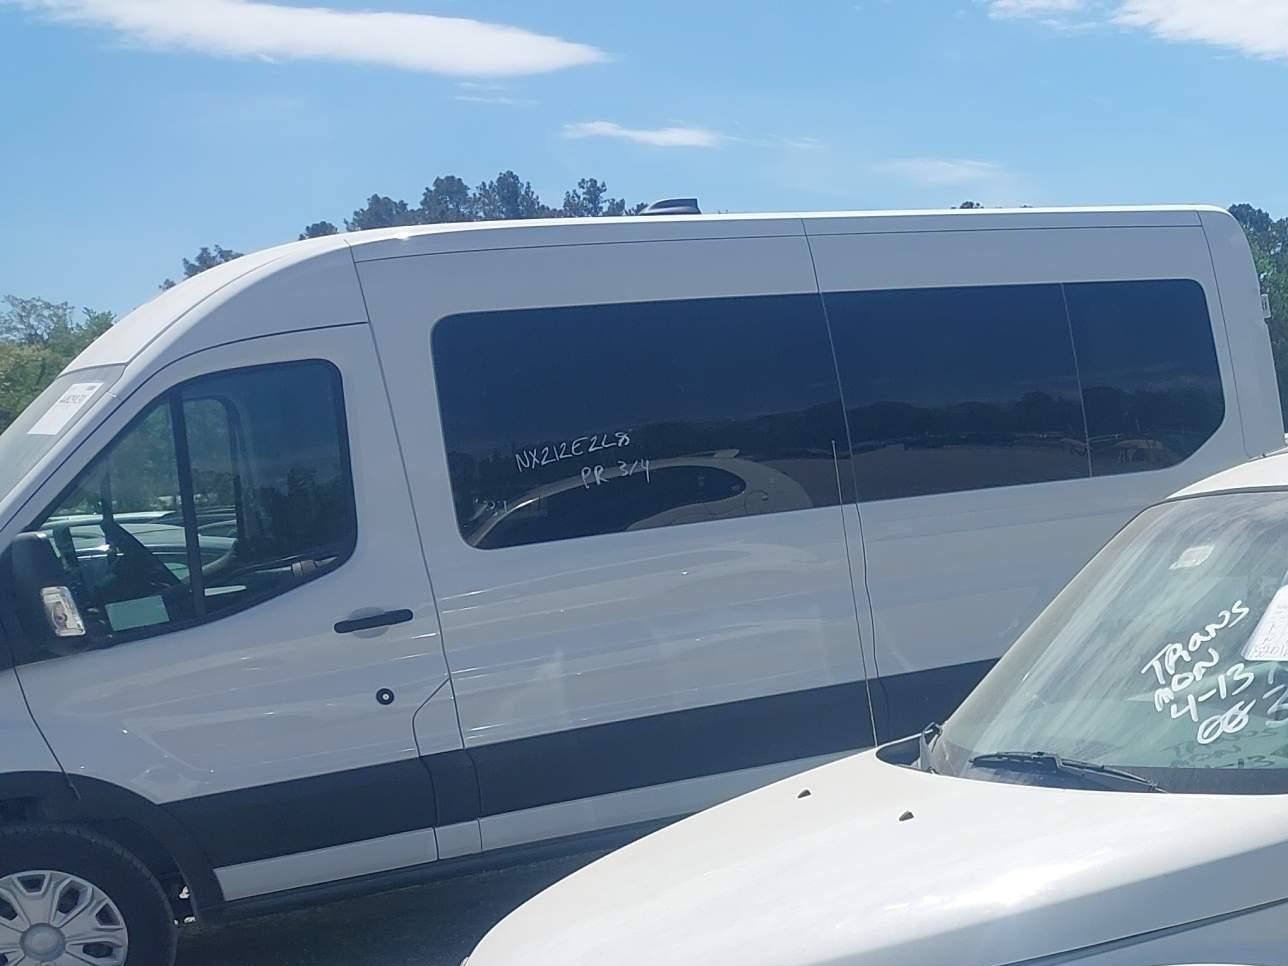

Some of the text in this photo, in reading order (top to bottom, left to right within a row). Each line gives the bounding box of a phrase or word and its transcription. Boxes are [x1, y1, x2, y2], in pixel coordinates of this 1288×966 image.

[580, 459, 651, 489] PR 3/4
[1170, 662, 1255, 722] 4-13
